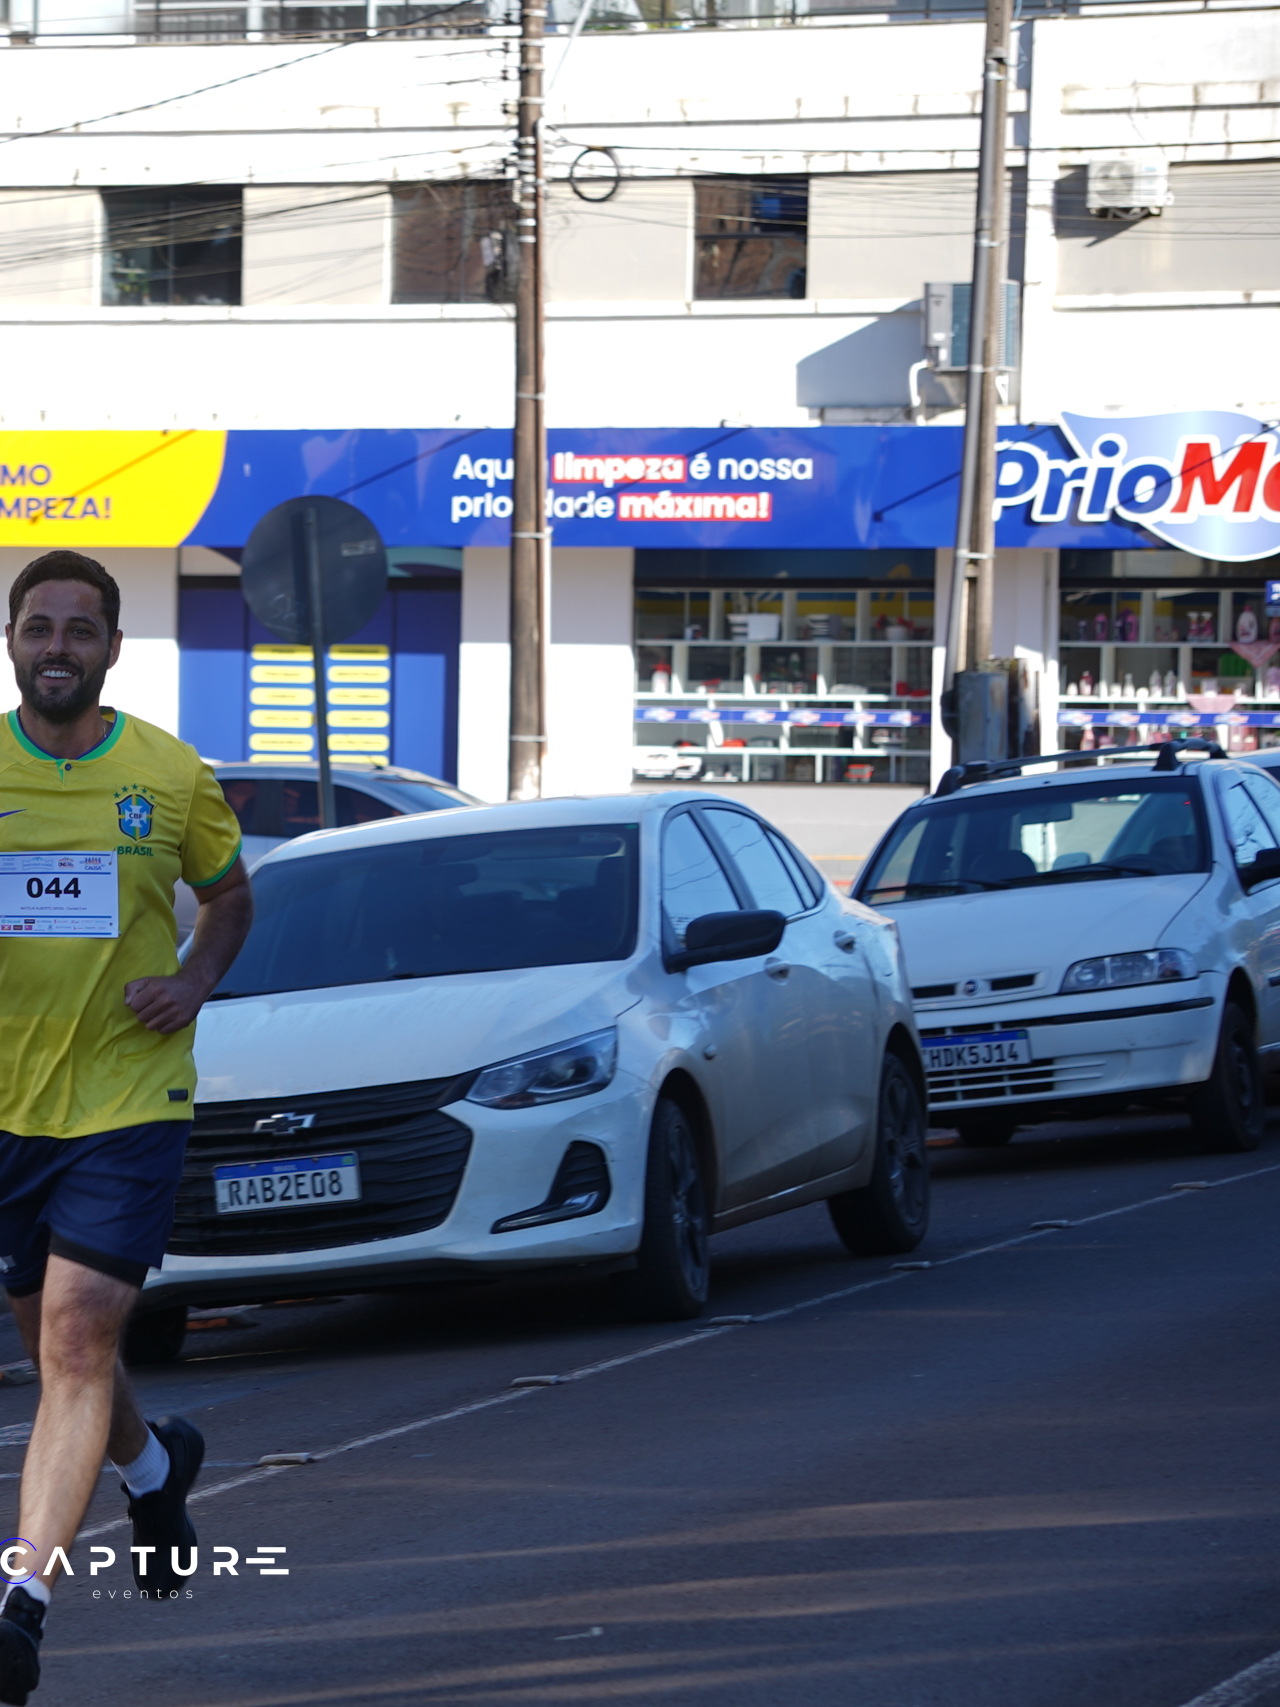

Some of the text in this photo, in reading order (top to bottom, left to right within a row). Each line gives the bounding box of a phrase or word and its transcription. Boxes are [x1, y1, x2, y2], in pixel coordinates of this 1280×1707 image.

[453, 453, 514, 488] Aqu
[554, 452, 683, 488] limpeza
[689, 453, 711, 480] é
[718, 458, 813, 480] nossa
[993, 434, 1280, 523] PrioM
[451, 488, 769, 523] prioade máxima!
[128, 812, 144, 820] CBF
[117, 846, 155, 857] BRASIL
[26, 877, 81, 899] 044
[930, 1043, 1019, 1068] HDK5J14
[228, 1170, 342, 1206] RAB2E08
